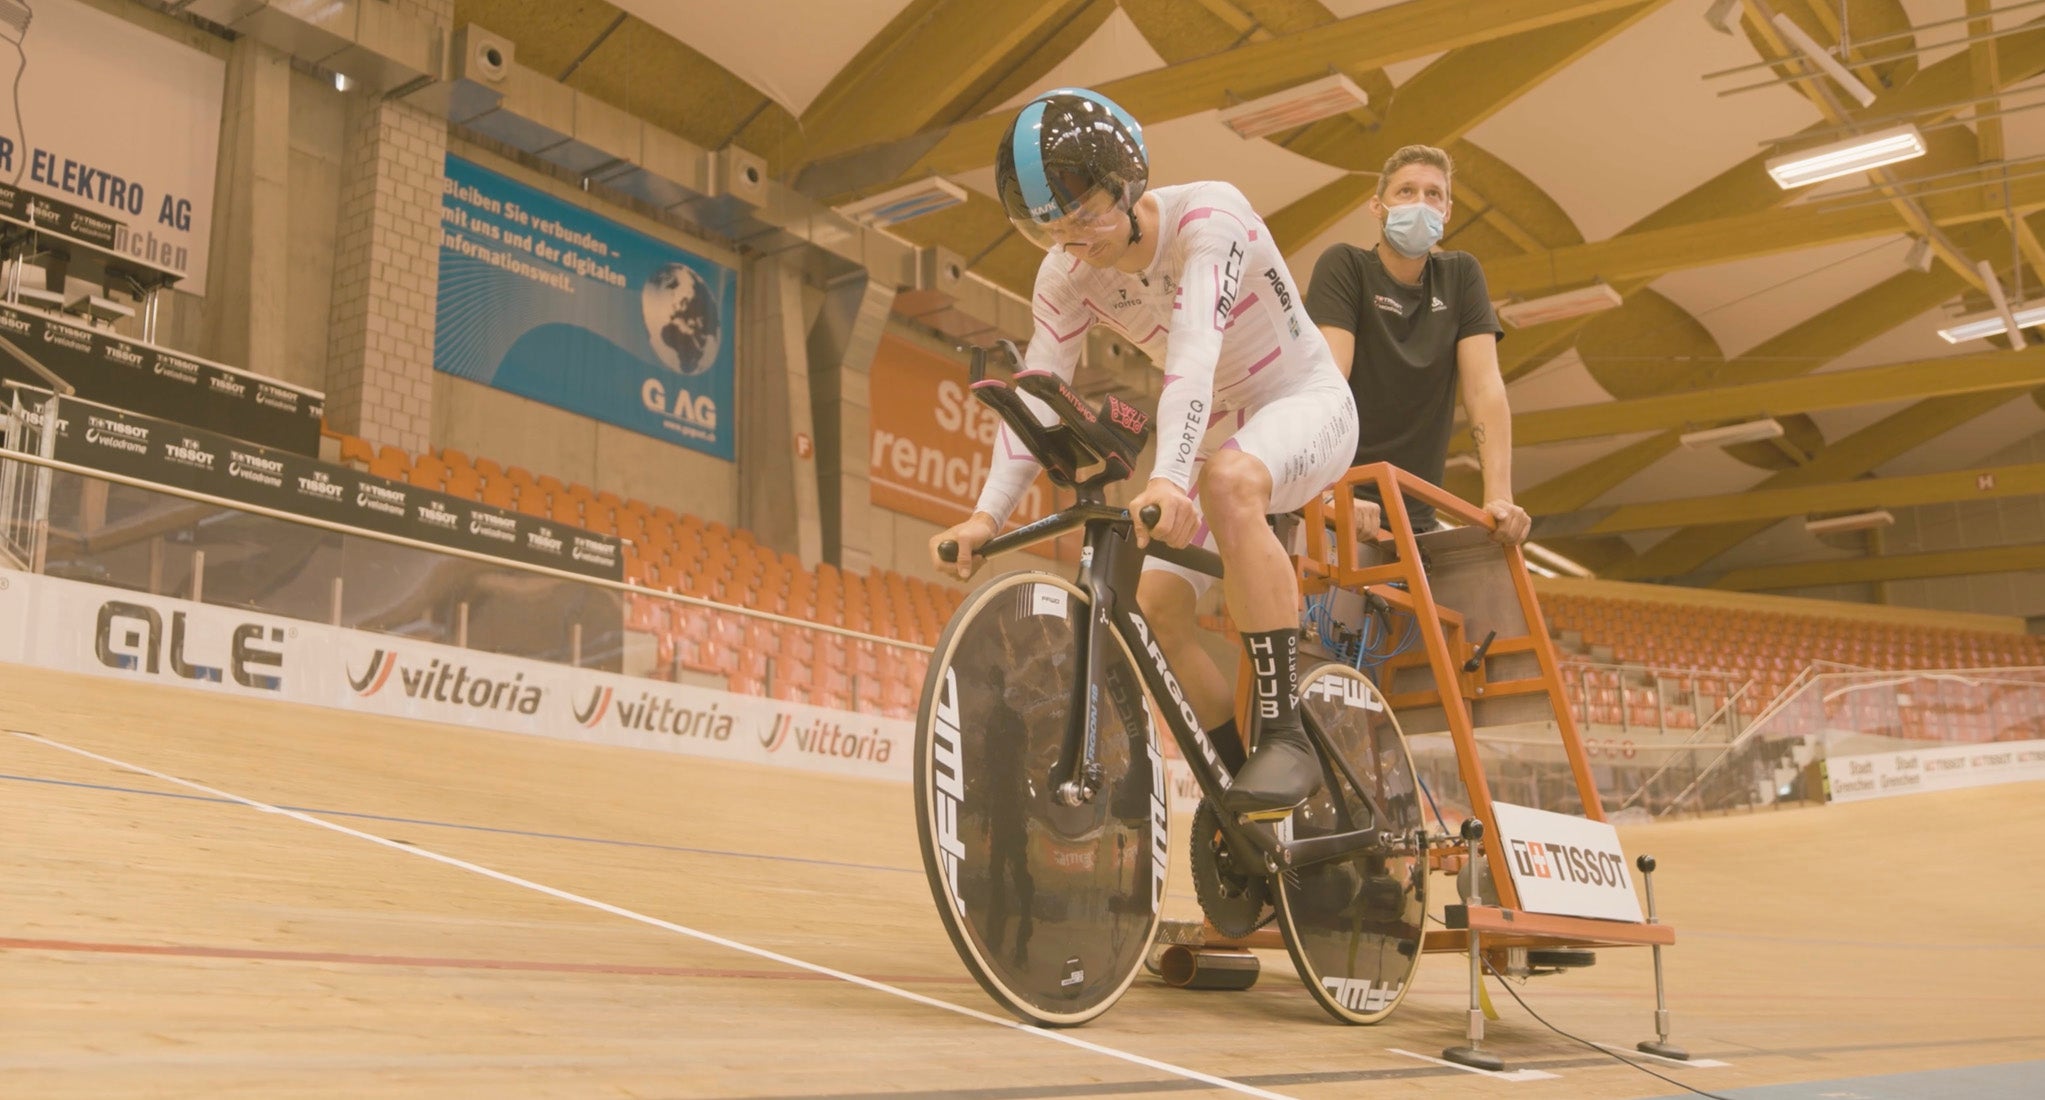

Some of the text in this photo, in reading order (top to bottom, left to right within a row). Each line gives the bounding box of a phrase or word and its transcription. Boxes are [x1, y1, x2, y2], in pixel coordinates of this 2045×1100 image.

[31, 148, 144, 216] ELEKTRO
[158, 194, 192, 232] AG
[444, 177, 501, 214] Bleiben
[504, 201, 528, 225] Sie
[531, 215, 608, 255] verbunden
[440, 228, 575, 294] Informationswelt.
[441, 205, 627, 289] mit uns und der digitalen
[1264, 268, 1293, 313] PIGGY
[105, 345, 143, 364] TISSOT
[210, 376, 245, 394] TISSOT
[99, 435, 147, 454] velodrome
[105, 420, 149, 439] TISSOT
[1176, 399, 1204, 464] VORTEQ
[165, 443, 214, 465] TISSOT
[244, 454, 283, 473] TISSOT
[871, 430, 1042, 519] renchn
[298, 476, 343, 498] TISSOT
[372, 485, 405, 502] TISSOT
[418, 505, 458, 525] TISSOT
[401, 658, 542, 715] vittoria
[1250, 636, 1279, 719] HUUB
[1287, 636, 1298, 694] VORTEQ
[1128, 612, 1217, 766] ARGON
[617, 692, 735, 742] vittoria
[795, 719, 896, 763] vittoria
[1545, 843, 1627, 889] TISSOT
